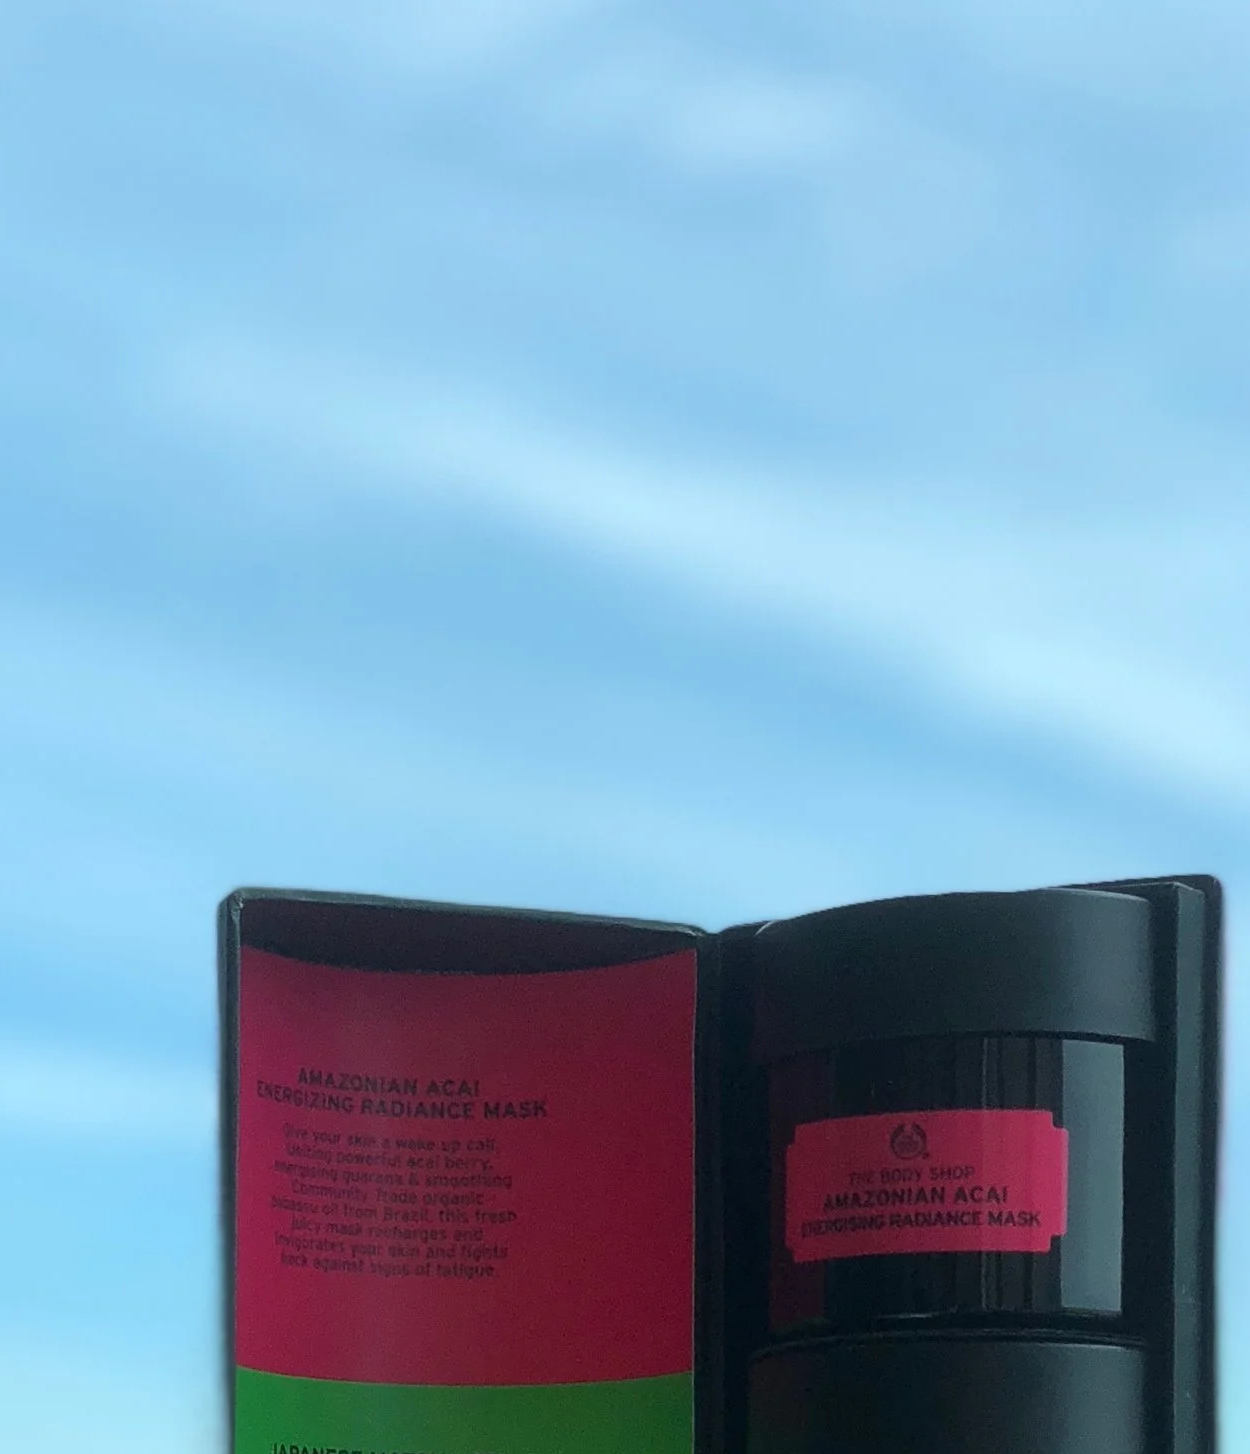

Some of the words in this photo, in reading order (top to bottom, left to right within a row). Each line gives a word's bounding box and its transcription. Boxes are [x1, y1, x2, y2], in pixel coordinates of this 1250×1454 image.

[298, 1068, 417, 1095] AMAZONIAN
[426, 1079, 479, 1096] ACAI
[361, 1100, 473, 1120] RADIANCE
[484, 1095, 547, 1119] MASK
[880, 1169, 921, 1181] BODY
[930, 1165, 975, 1180] SHOP
[824, 1187, 945, 1212] AMAZONIAN
[954, 1186, 1007, 1203] ACAI
[890, 1212, 980, 1227] RADIANCE
[988, 1211, 1040, 1227] MASK
